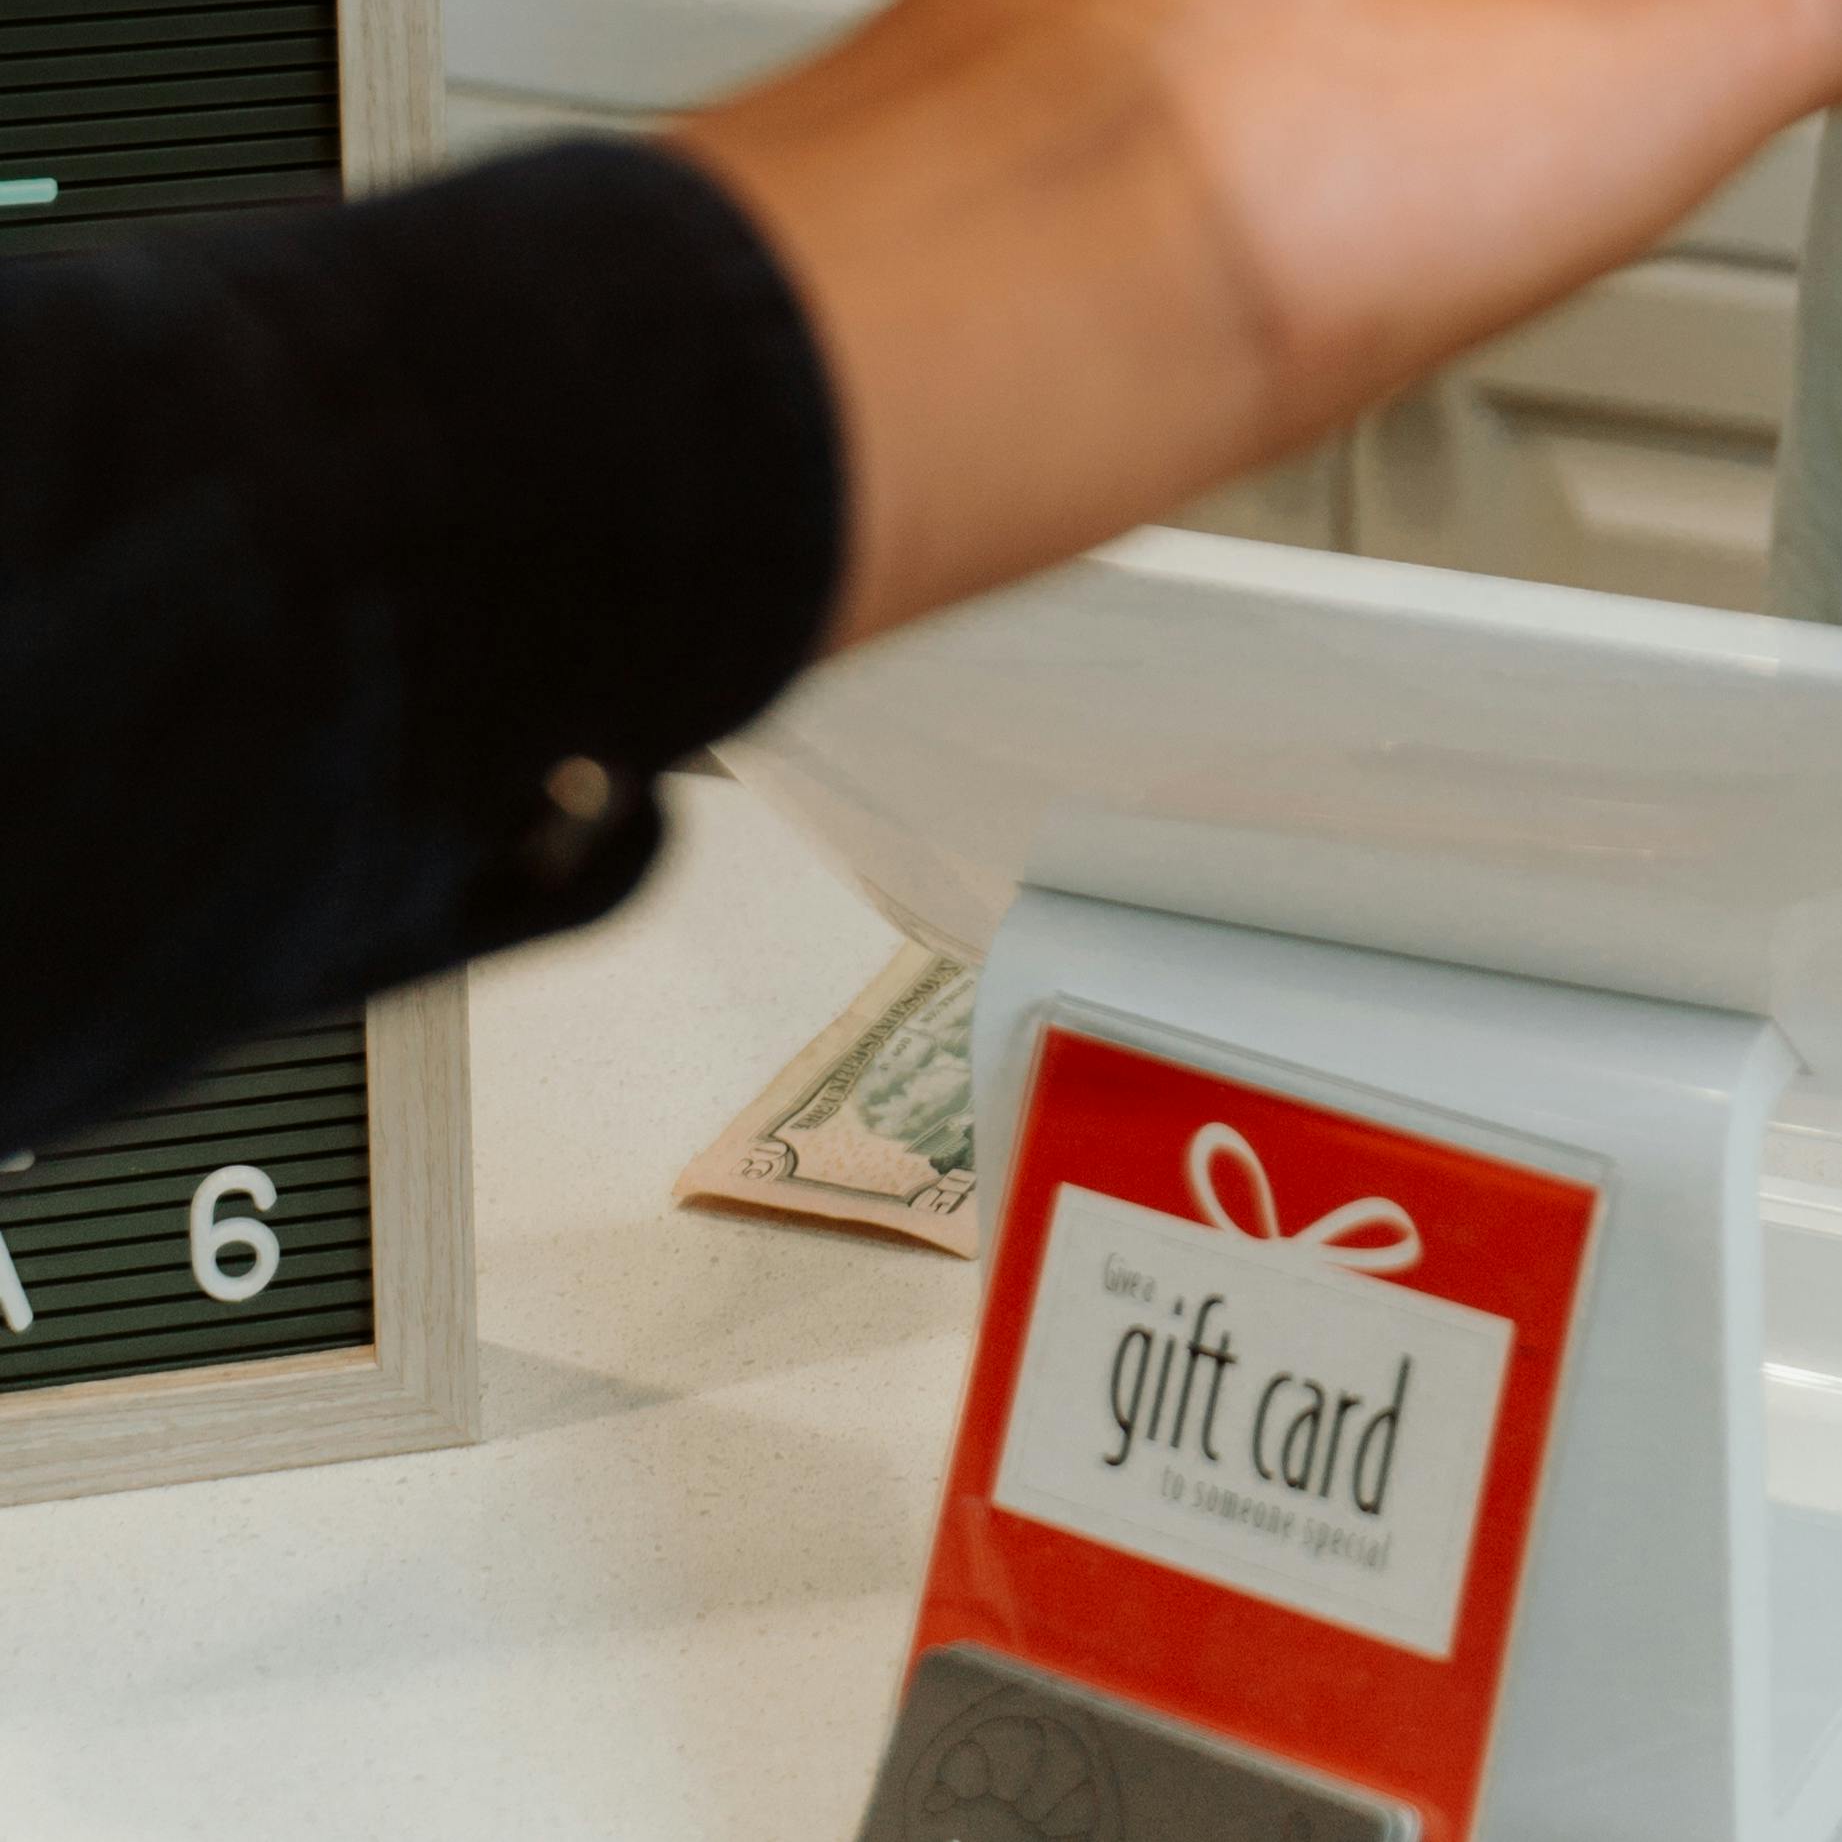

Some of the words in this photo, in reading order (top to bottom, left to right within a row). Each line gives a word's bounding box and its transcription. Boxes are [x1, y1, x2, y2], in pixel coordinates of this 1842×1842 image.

[189, 1164, 280, 1303] 6
[1103, 1291, 1239, 1467] gift
[1252, 1350, 1412, 1515] card
[1161, 1466, 1186, 1502] to
[1192, 1480, 1296, 1539] someone
[1302, 1516, 1392, 1573] special
